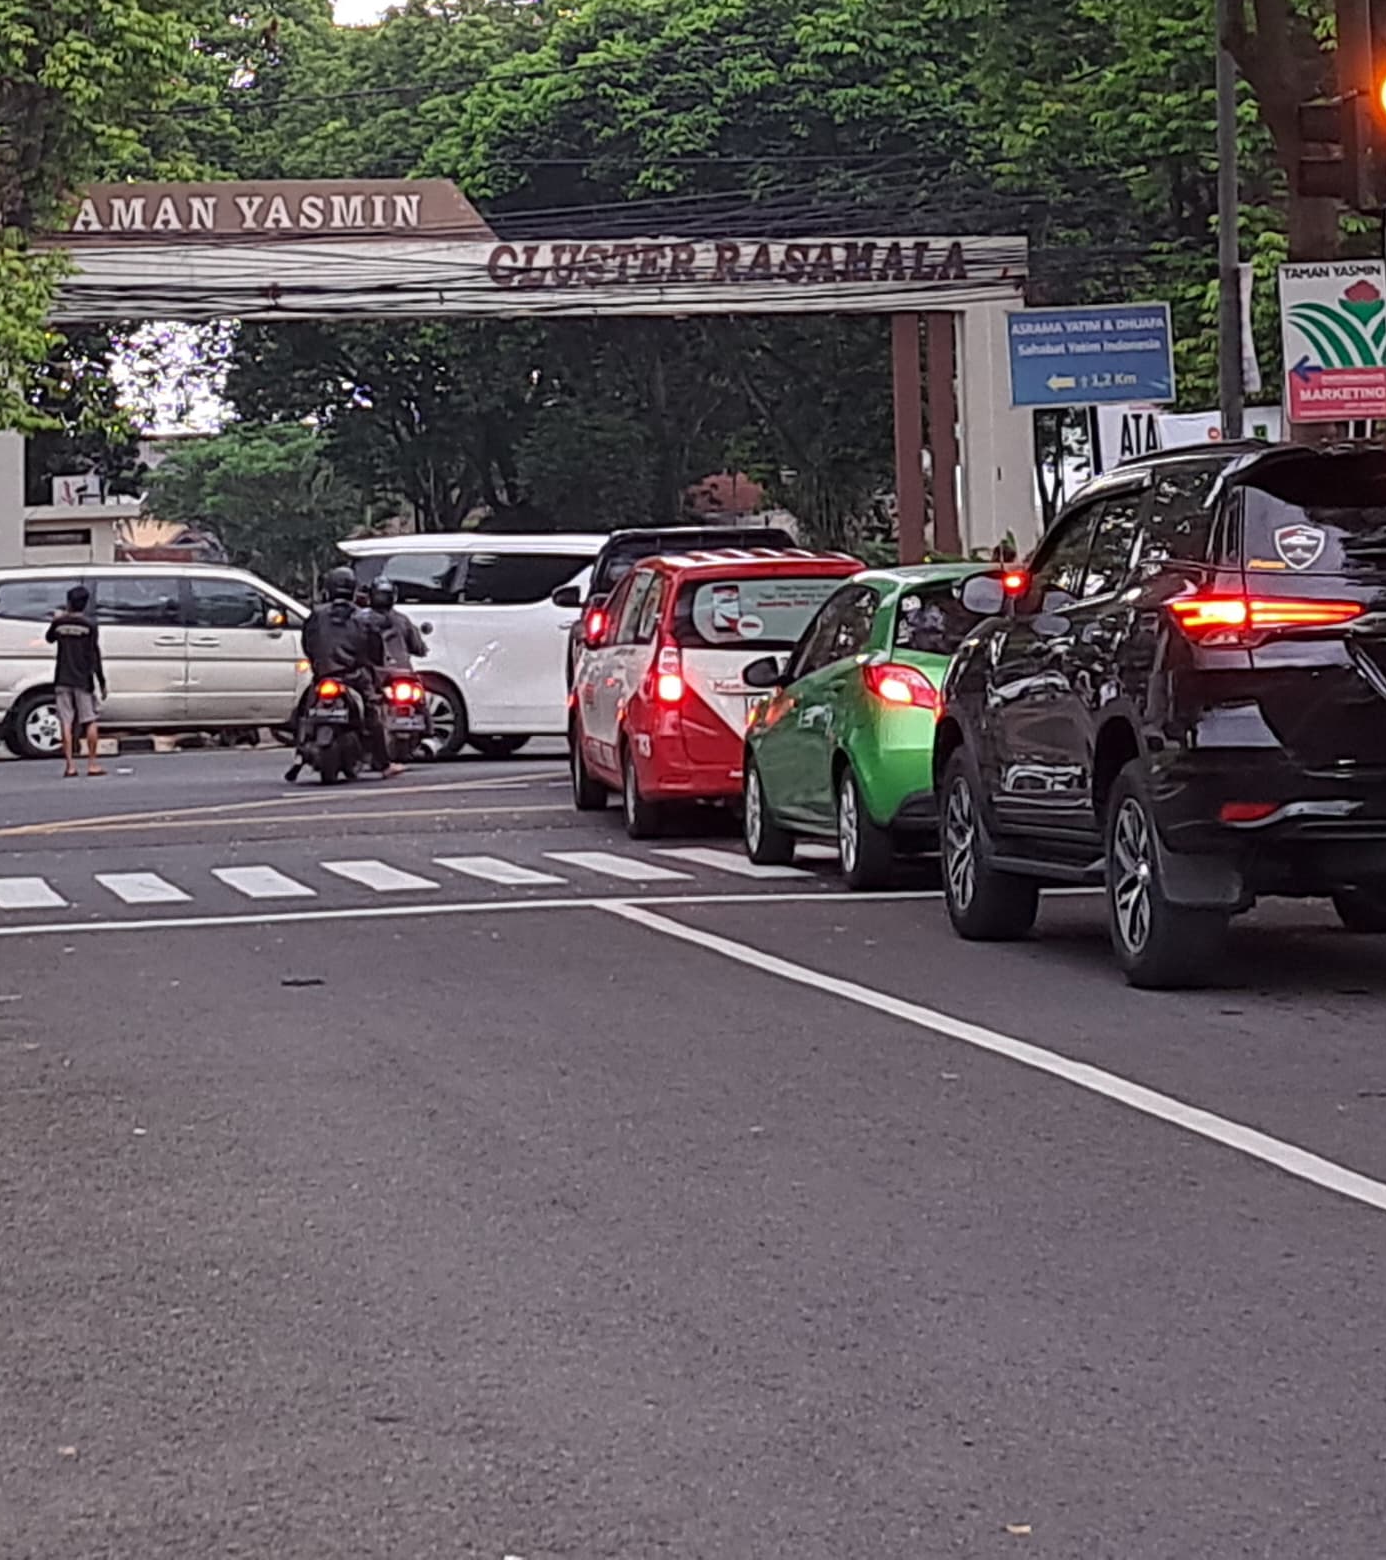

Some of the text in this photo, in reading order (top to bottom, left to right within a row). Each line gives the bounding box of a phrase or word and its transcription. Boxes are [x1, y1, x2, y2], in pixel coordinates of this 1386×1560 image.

[73, 194, 421, 231] AMAN YASMIN
[487, 241, 967, 286] CLUSTER RASAMALA
[1283, 265, 1381, 280] TAMAN YASMIN
[1114, 373, 1137, 385] Km
[1300, 387, 1386, 401] MARKETING
